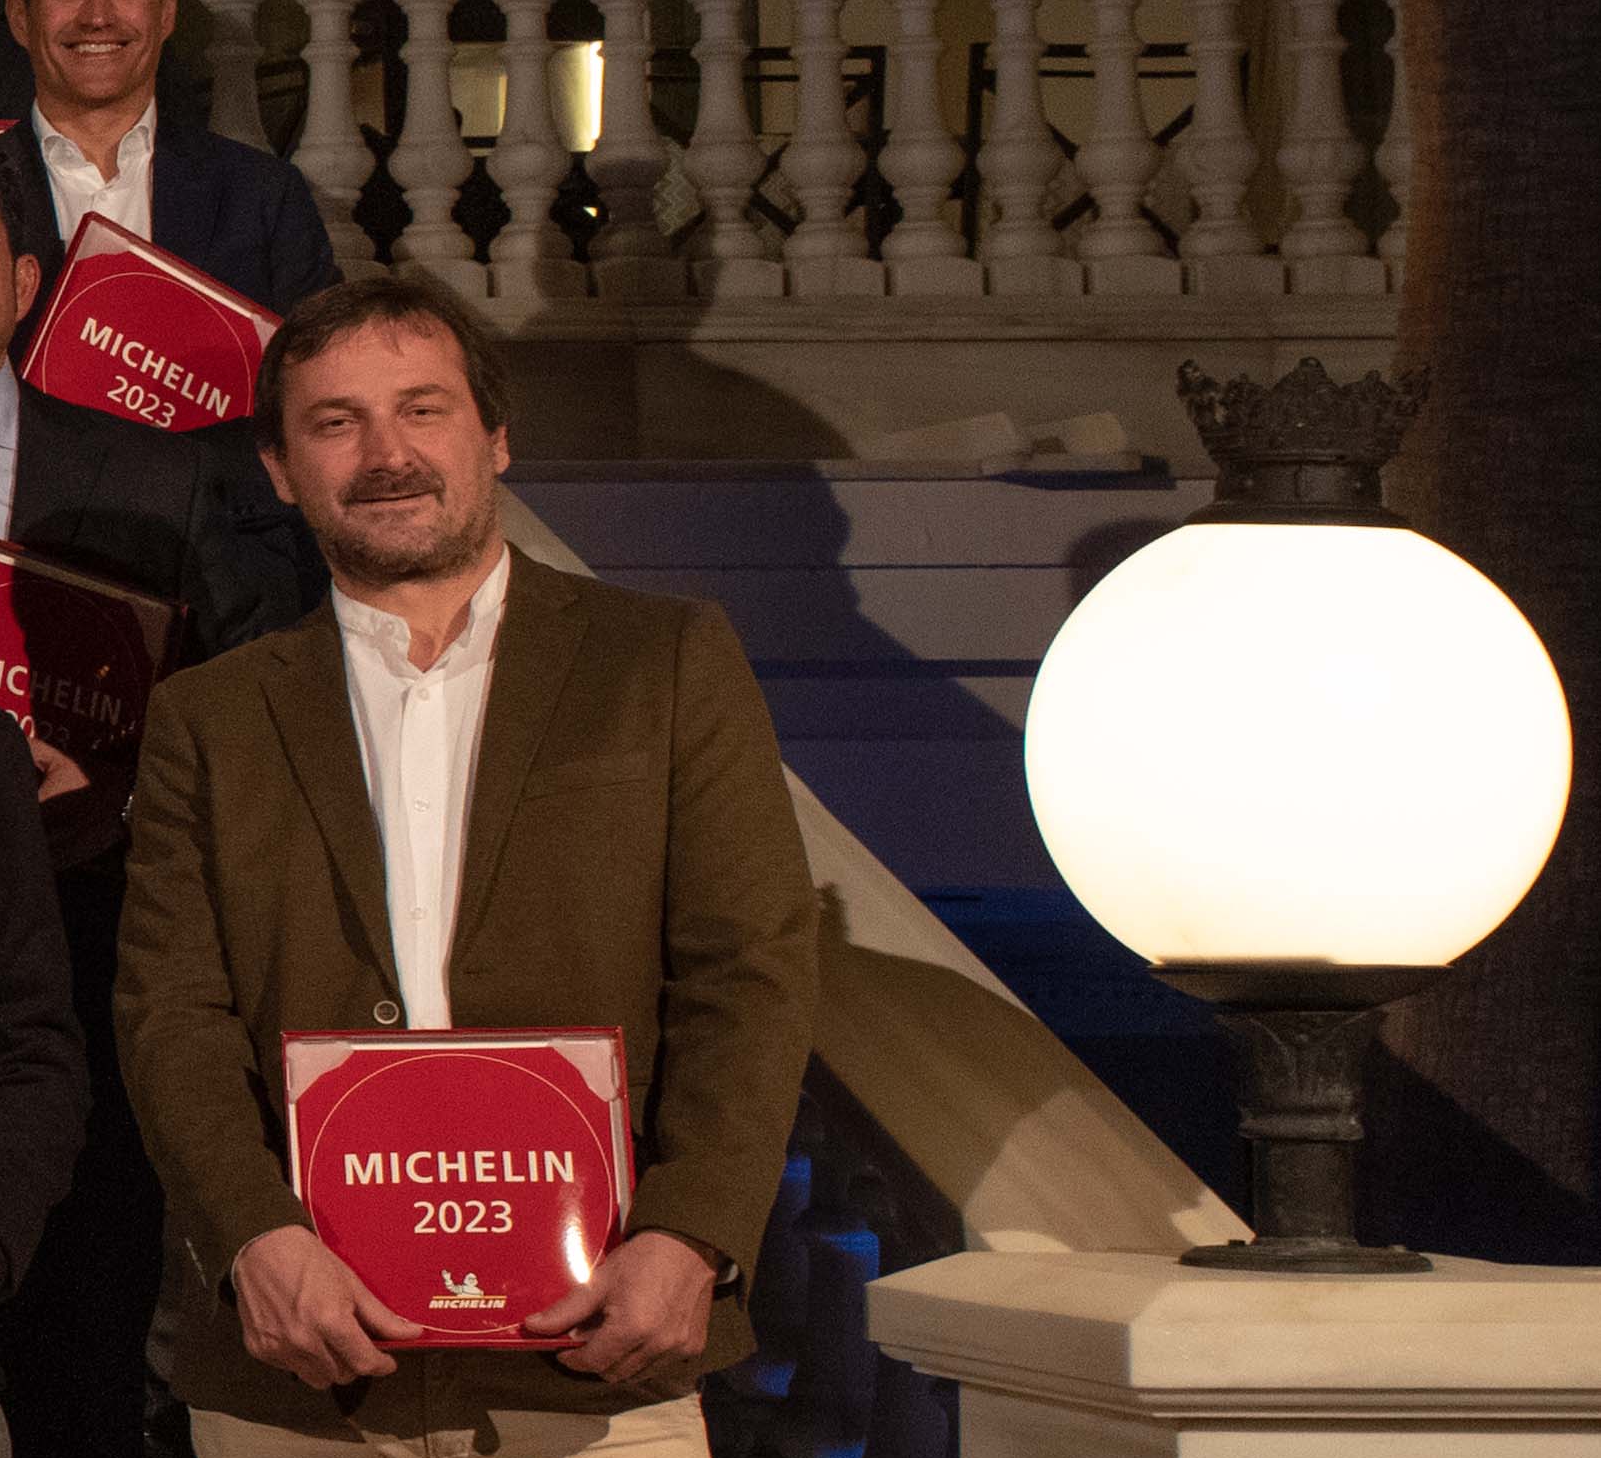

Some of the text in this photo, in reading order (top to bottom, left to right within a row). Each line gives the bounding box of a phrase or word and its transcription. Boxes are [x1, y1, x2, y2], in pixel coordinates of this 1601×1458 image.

[80, 317, 230, 417] MICHELIN
[107, 375, 176, 428] 2023
[345, 1151, 574, 1185] MICHELIN
[414, 1200, 512, 1233] 2023
[428, 1298, 507, 1311] MICHELIN
